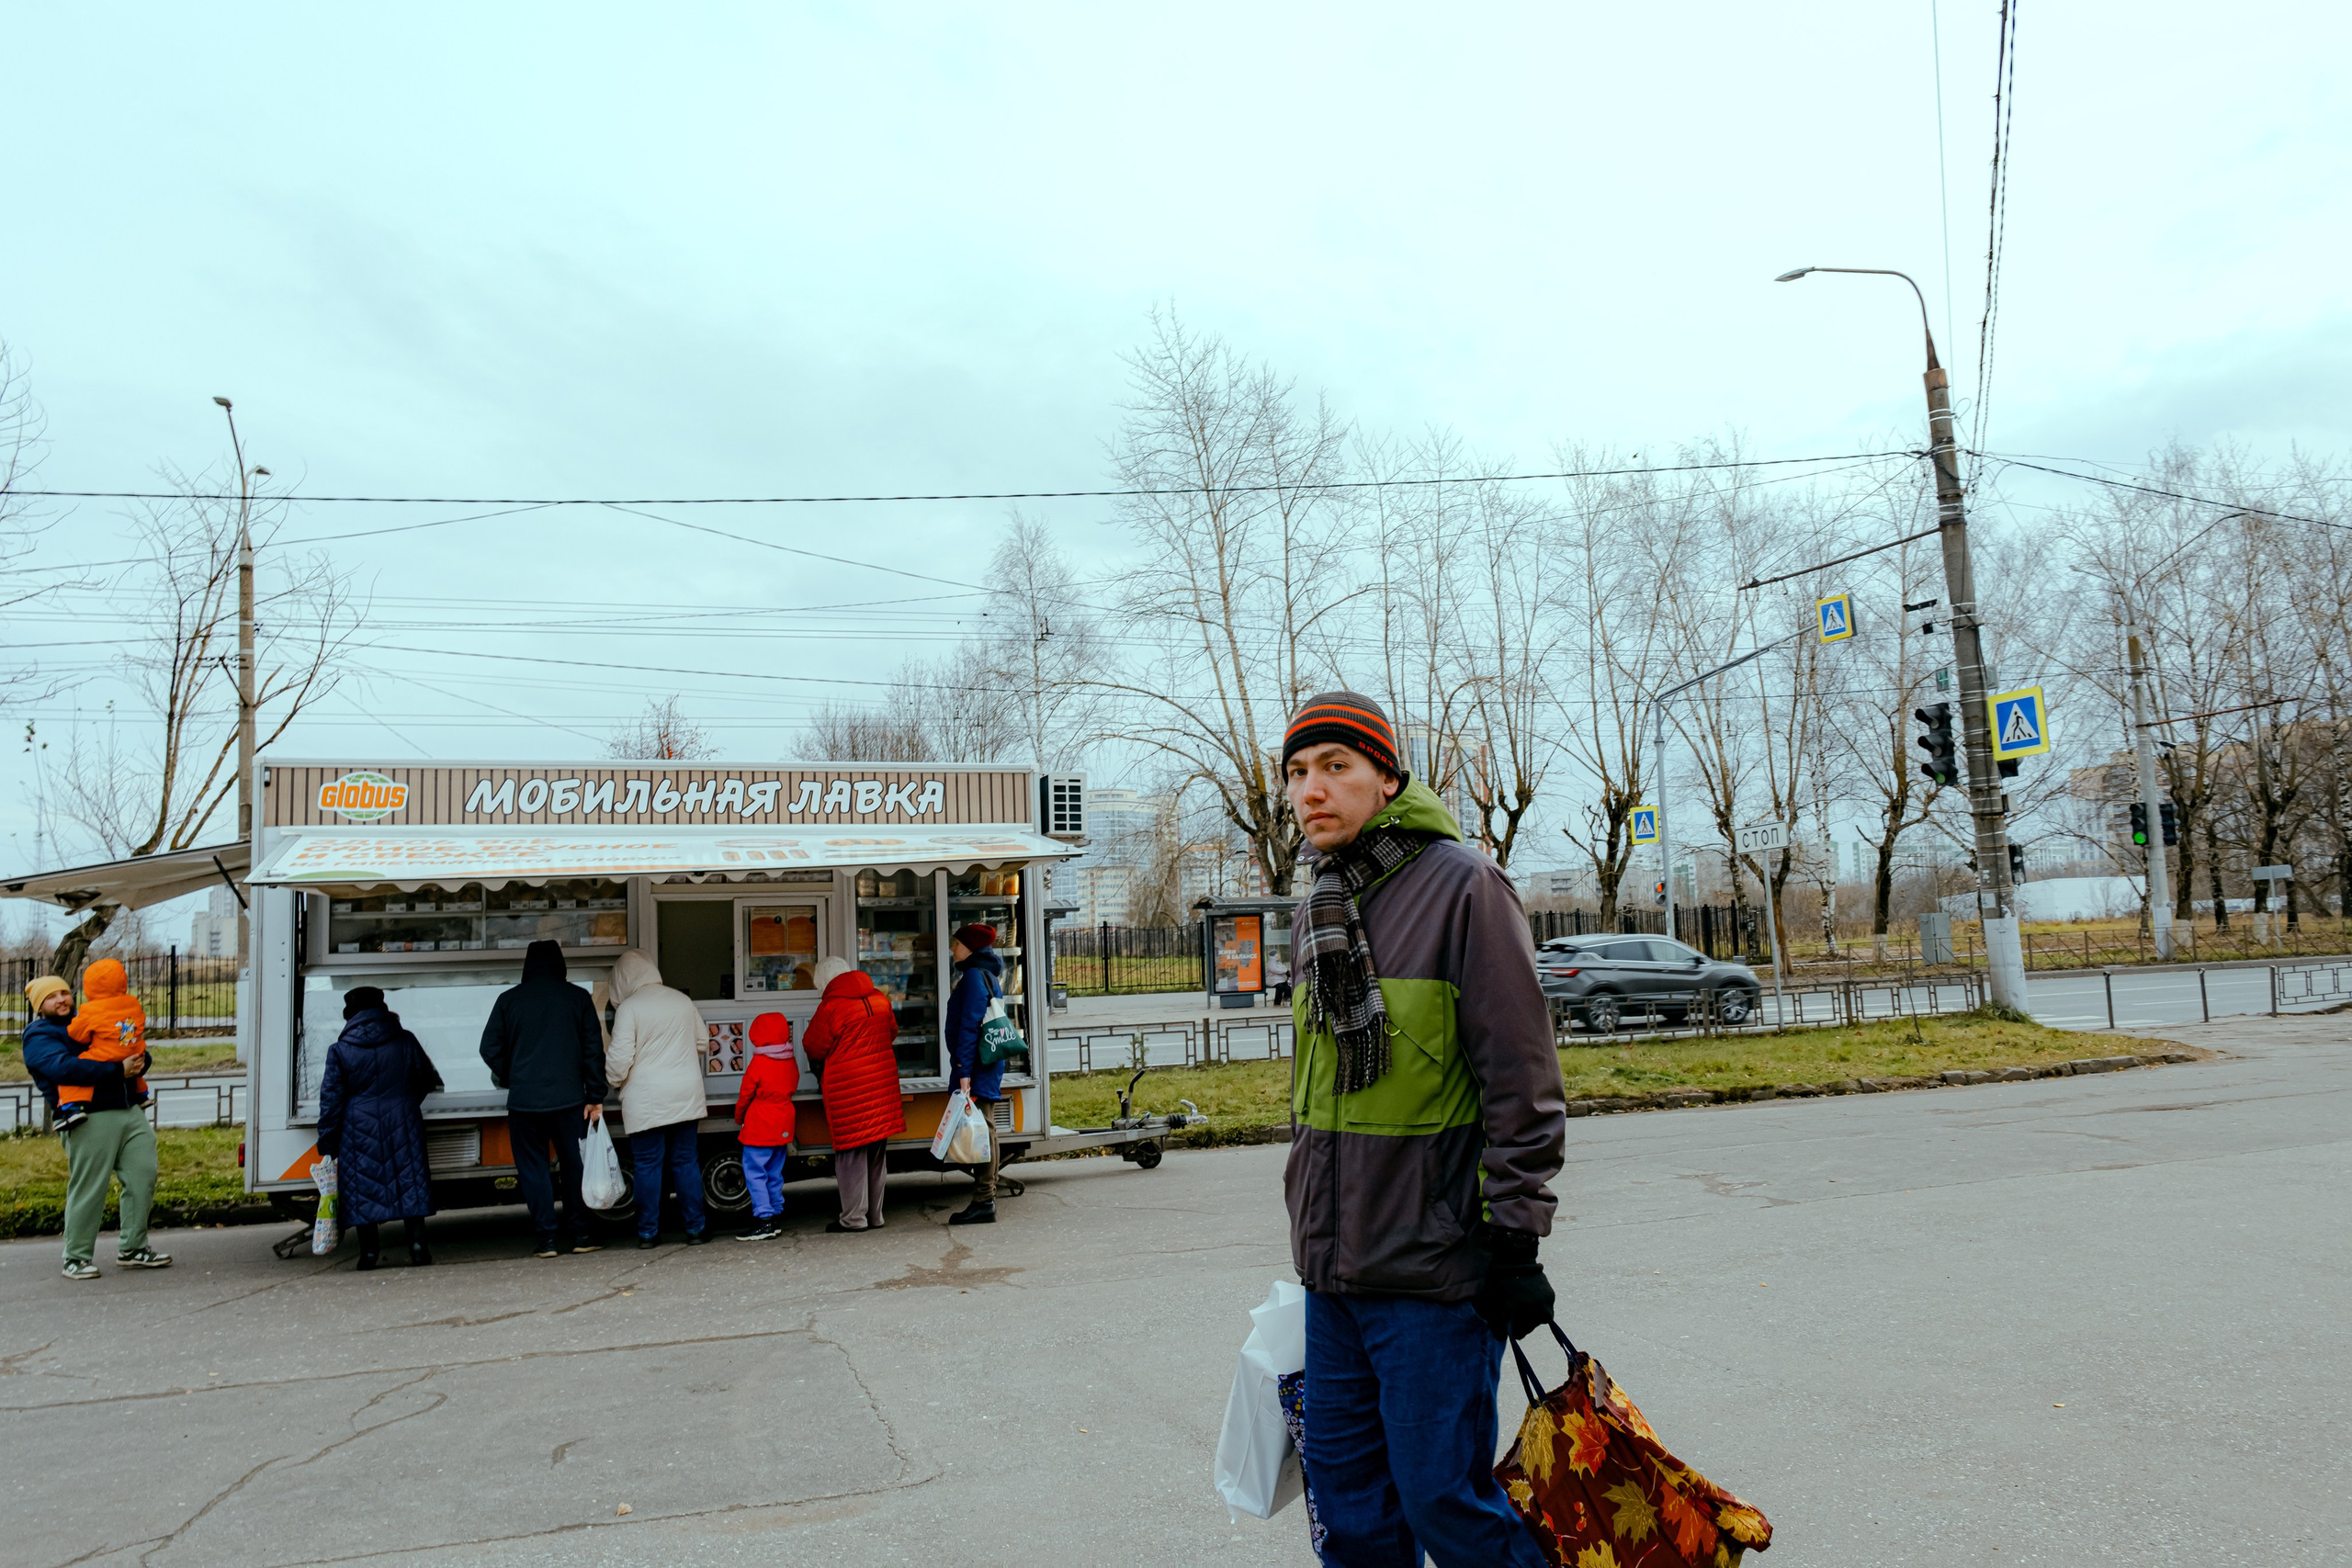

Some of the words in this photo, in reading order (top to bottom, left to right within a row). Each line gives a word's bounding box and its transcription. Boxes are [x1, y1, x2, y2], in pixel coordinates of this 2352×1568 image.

[1358, 741, 1394, 767] SPORT
[465, 778, 783, 818] МОБИЛЬНАЯ
[788, 779, 945, 818] ЛАВКА
[481, 842, 679, 851] ВКУСНОЕ
[1742, 828, 1779, 848] СТОП
[342, 851, 548, 860] СВЕЖЕЕ
